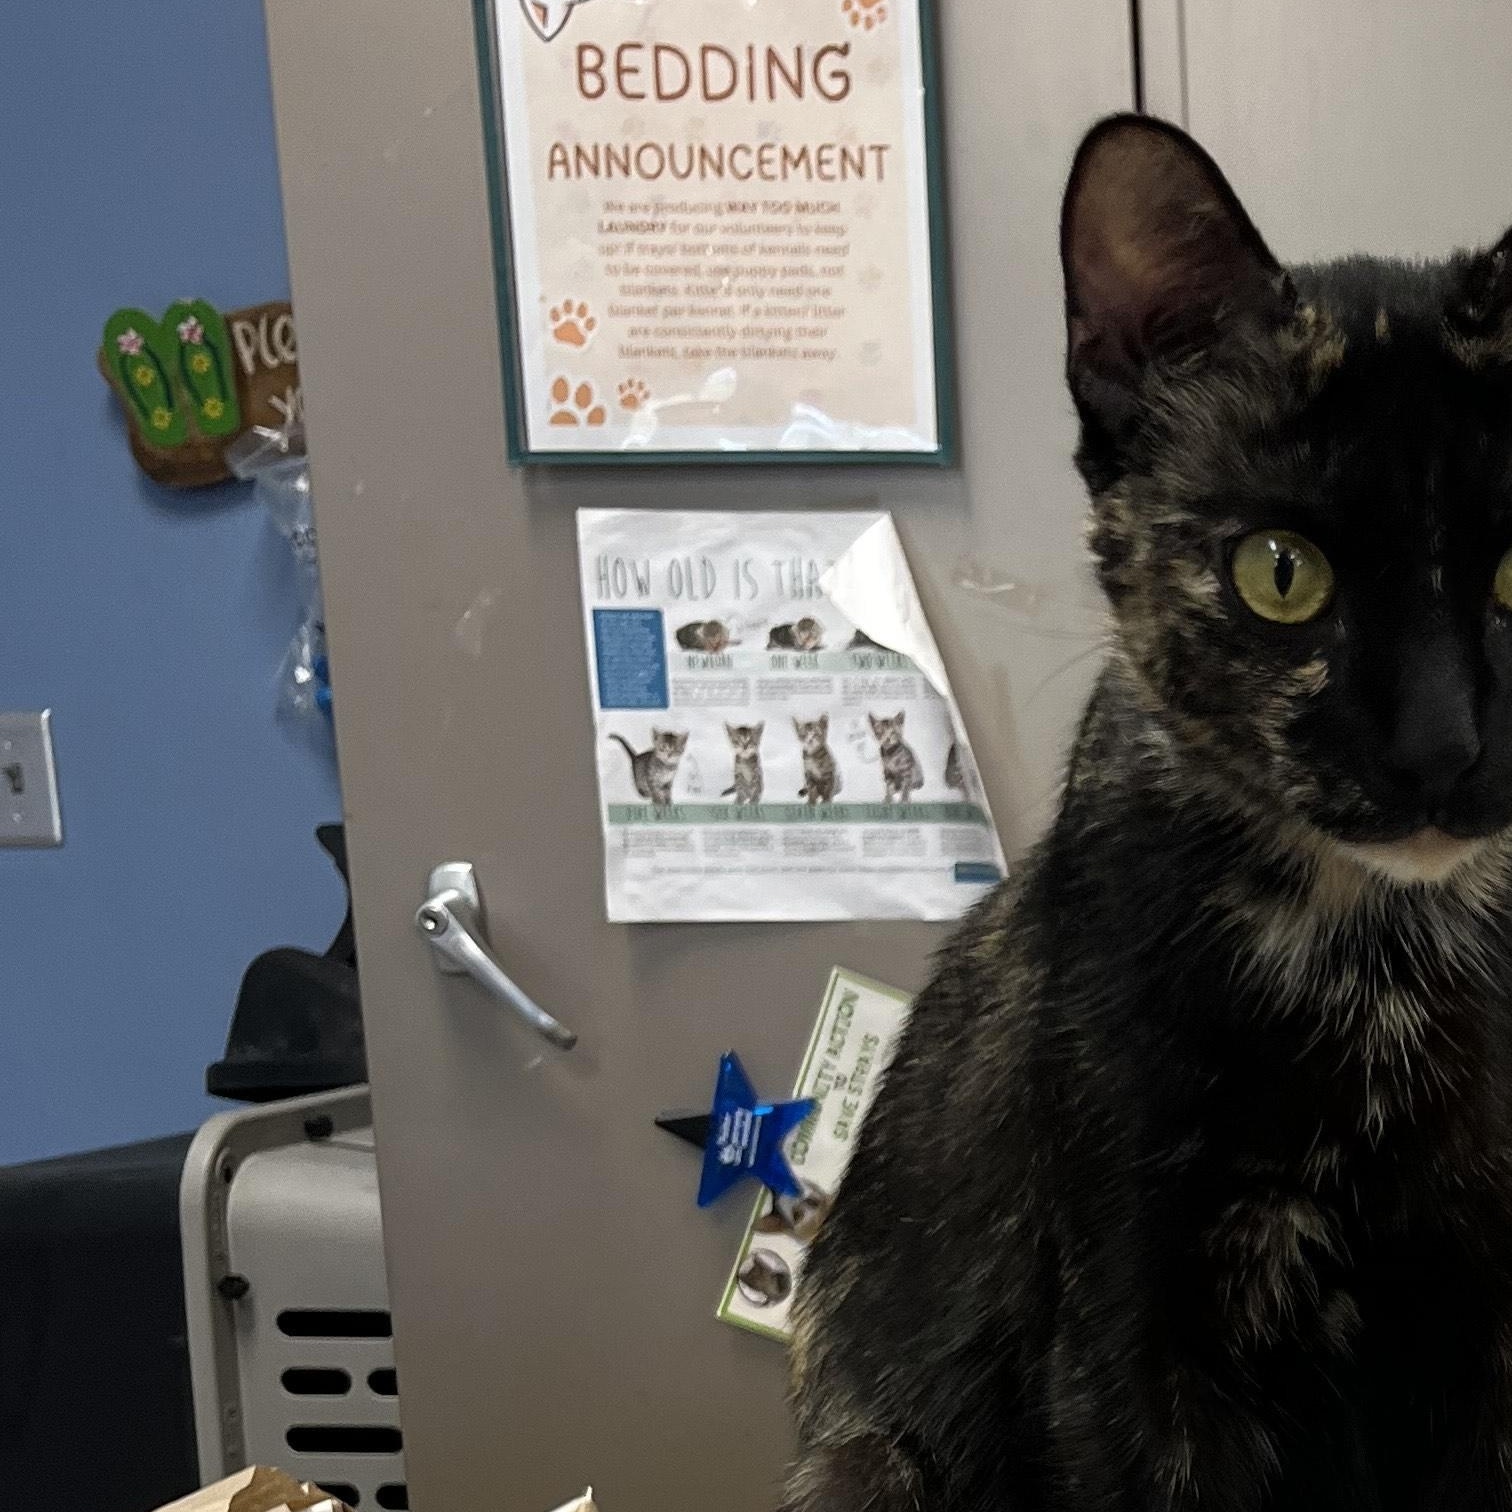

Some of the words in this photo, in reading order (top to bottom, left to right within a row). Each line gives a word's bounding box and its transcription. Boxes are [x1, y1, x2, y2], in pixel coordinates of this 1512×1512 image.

[576, 41, 852, 102] BEDDING
[547, 142, 891, 181] ANNOUNCEMENT
[594, 555, 650, 599] HOW
[668, 556, 716, 600] OLD
[734, 558, 758, 600] IS
[770, 556, 836, 600] THA
